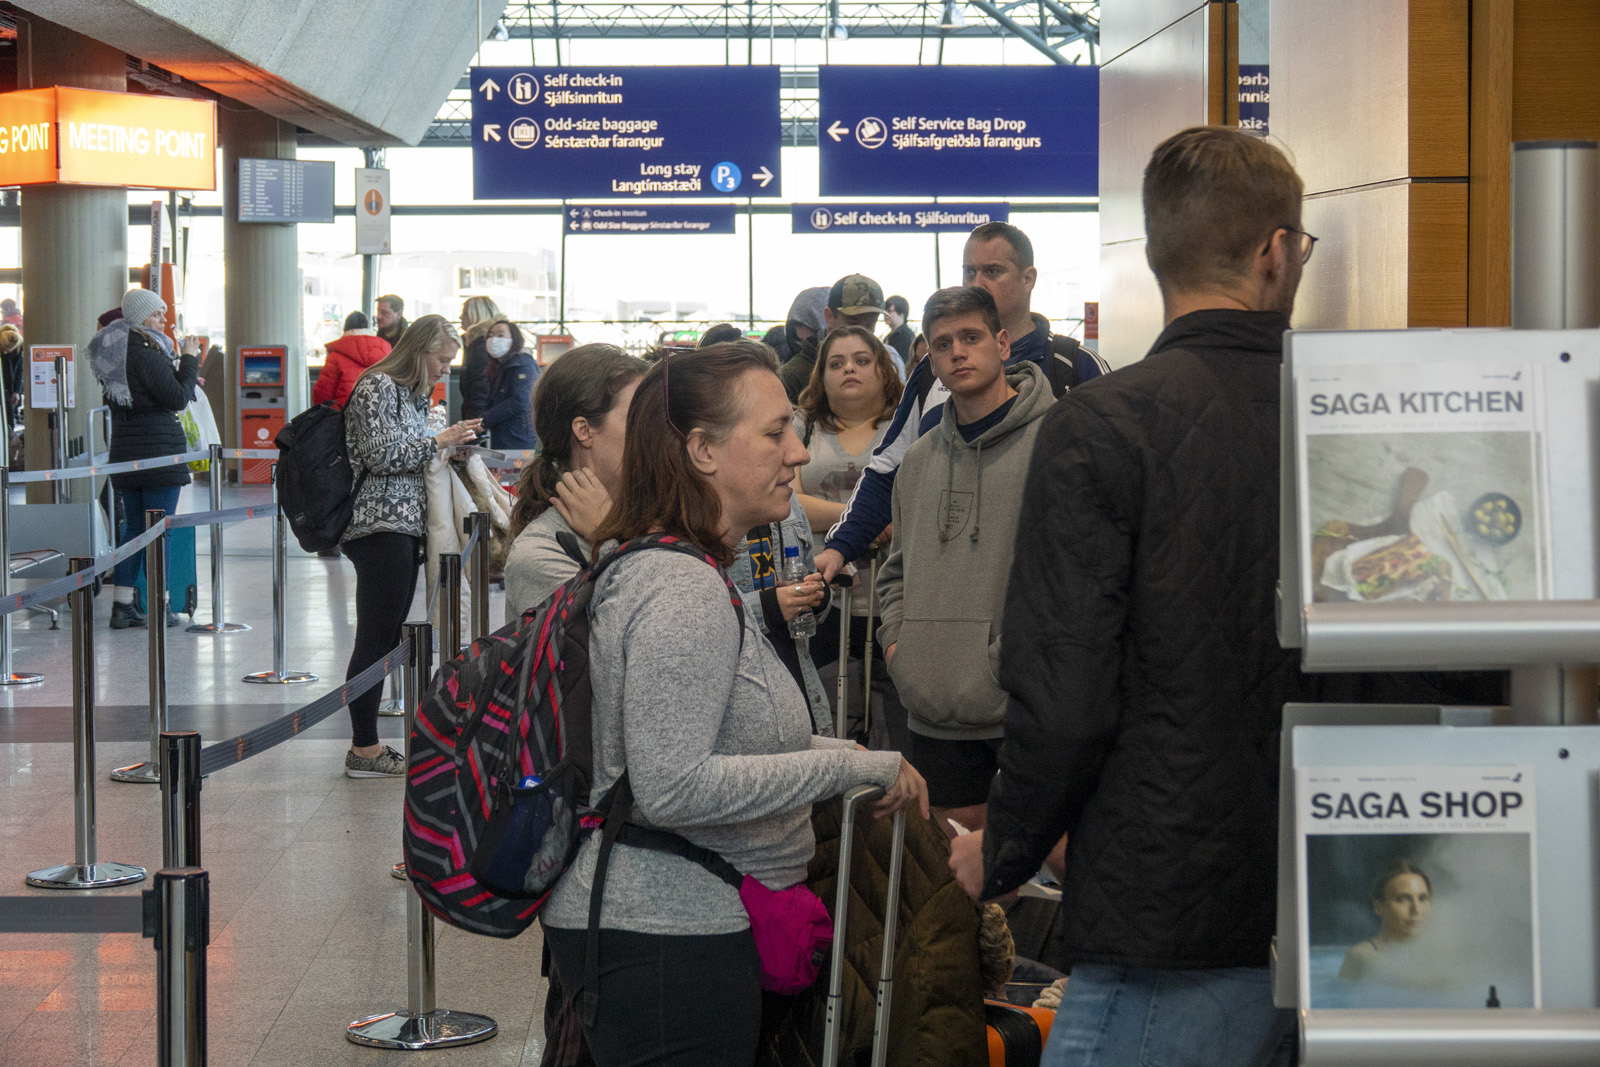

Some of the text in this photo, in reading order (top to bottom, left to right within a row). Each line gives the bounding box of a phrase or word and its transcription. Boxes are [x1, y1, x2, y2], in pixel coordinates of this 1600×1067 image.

[544, 73, 623, 87] Self check-in
[544, 91, 623, 107] Sjálfsinnritun
[545, 117, 658, 133] Odd-size baggage
[892, 116, 1027, 133] Self Service Bag Drop
[11, 122, 50, 153] POINT
[68, 121, 207, 159] MEETING POINT
[545, 134, 665, 151] Sérstærðar farangur
[892, 133, 1042, 150] Sjálfsafgreiðsla farangurs
[640, 163, 702, 178] Long stay
[612, 178, 702, 195] Langtímastæði
[834, 211, 990, 227] Self check-in Sjálfsinnritun
[1310, 391, 1525, 416] SAGA KITCHEN
[1310, 790, 1524, 819] SAGA SHOP
